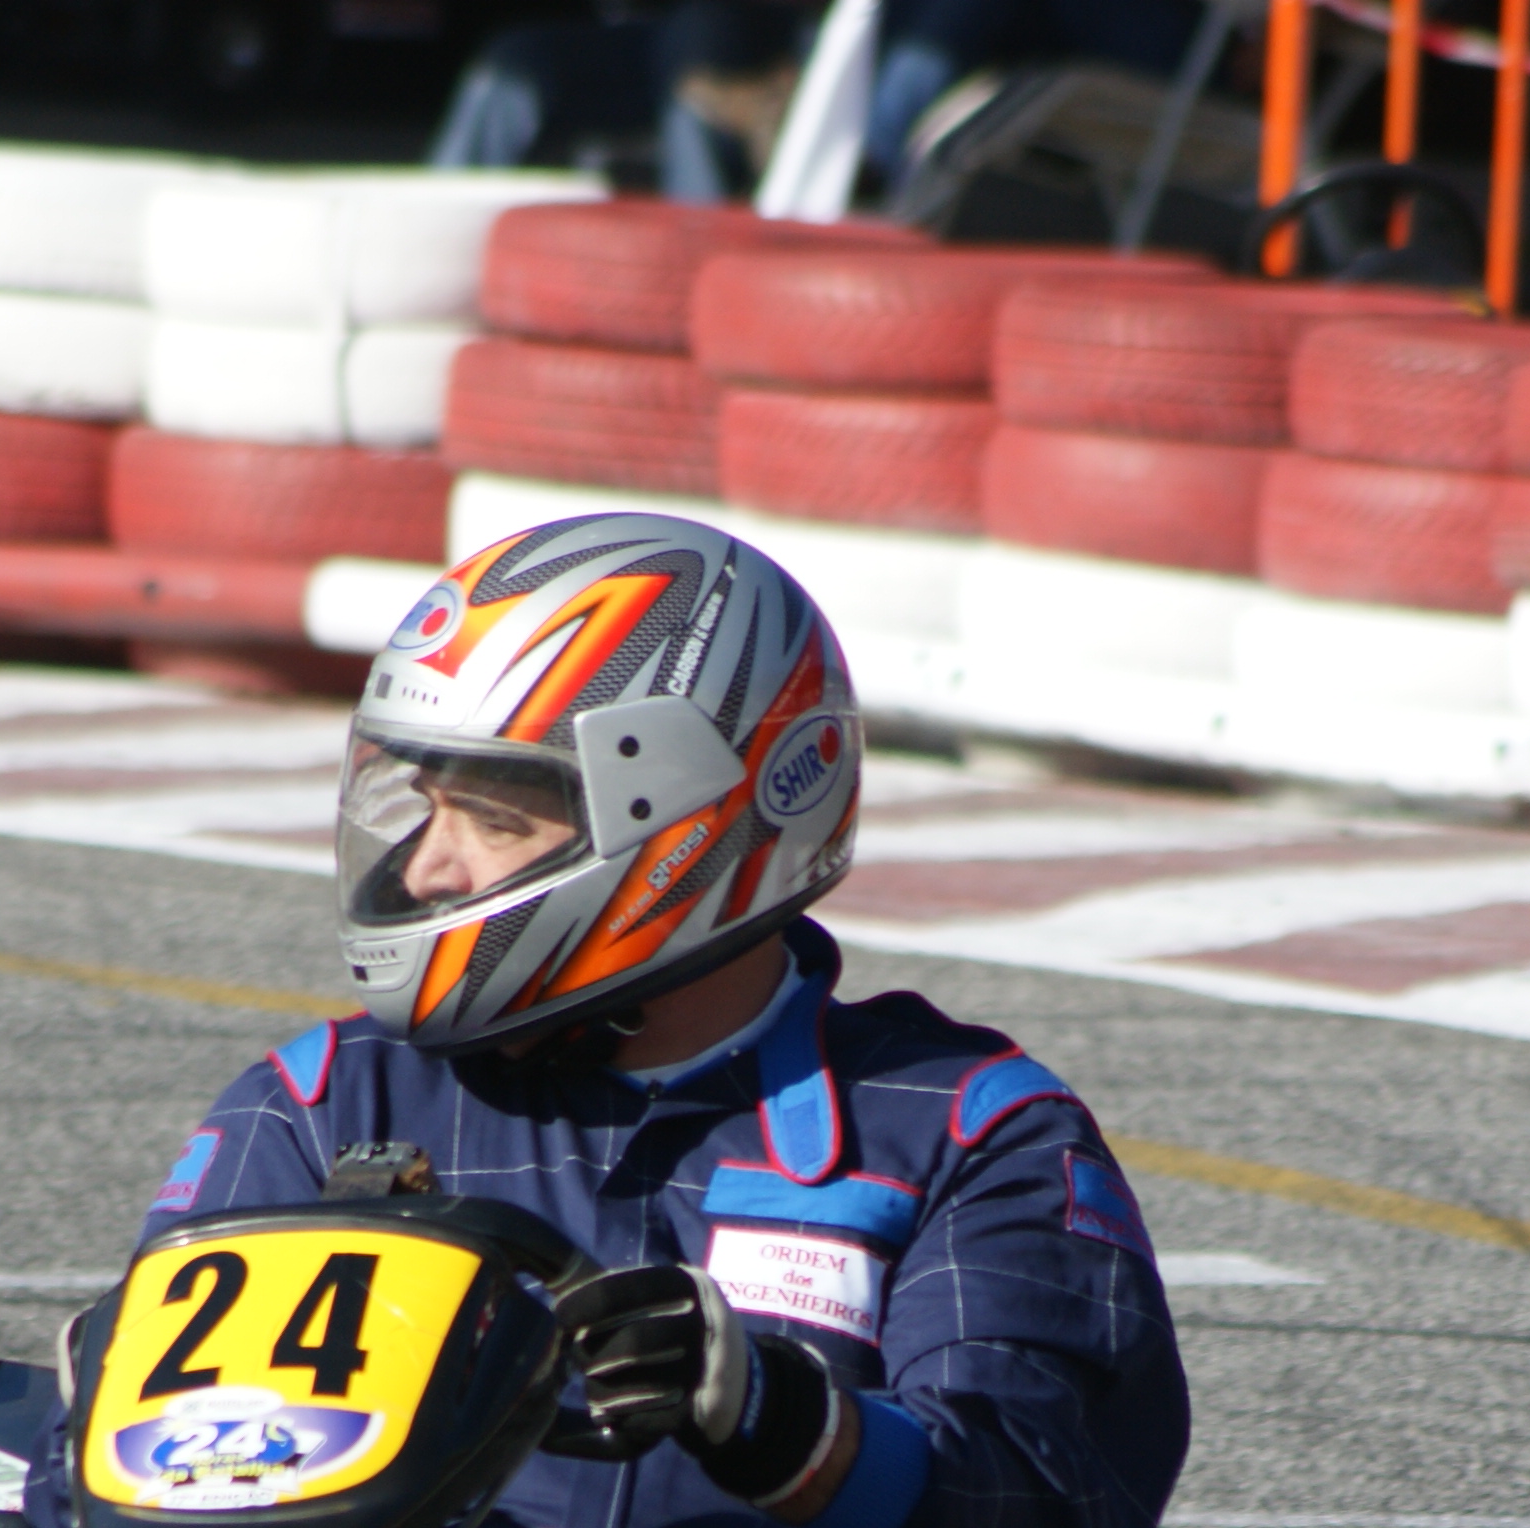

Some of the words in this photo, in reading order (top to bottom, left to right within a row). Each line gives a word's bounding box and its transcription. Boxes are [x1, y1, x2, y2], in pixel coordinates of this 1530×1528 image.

[668, 636, 705, 696] CARBON
[647, 822, 709, 890] ghost
[761, 1244, 847, 1274] ORDEM
[783, 1269, 813, 1288] dos
[138, 1250, 381, 1404] 24
[167, 1423, 267, 1466] 24
